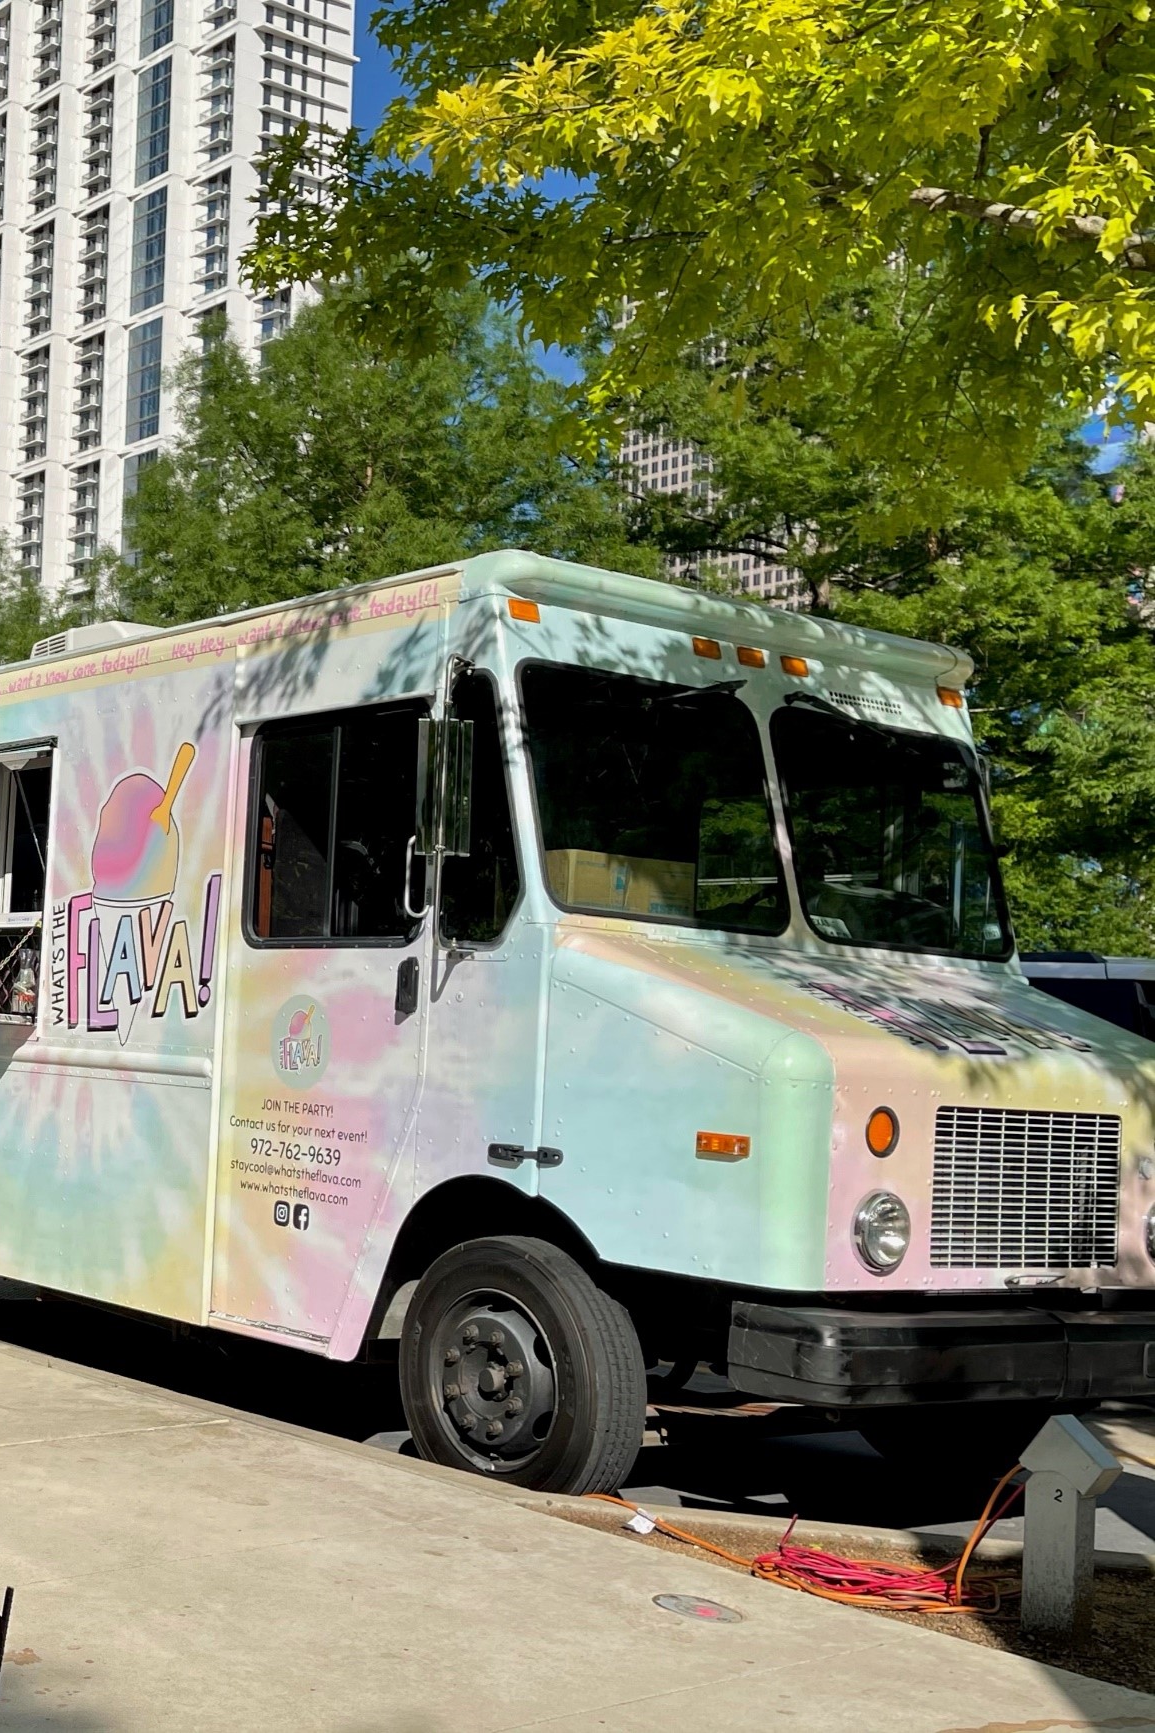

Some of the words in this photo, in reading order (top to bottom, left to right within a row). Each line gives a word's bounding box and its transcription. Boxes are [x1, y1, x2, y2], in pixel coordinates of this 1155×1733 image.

[276, 622, 283, 636] a
[370, 582, 439, 618] today!?!
[51, 902, 66, 945] THE
[67, 874, 222, 1032] FLAVA!
[51, 947, 66, 1026] WHAT'S
[261, 1099, 281, 1112] JOIN
[284, 1101, 300, 1114] THE
[302, 1103, 334, 1118] PARTY!
[230, 1115, 264, 1130] Contact
[265, 1121, 276, 1132] us
[277, 1120, 291, 1134] for
[292, 1124, 312, 1138] your
[315, 1124, 336, 1139] next
[338, 1130, 368, 1143] event!
[250, 1138, 341, 1166] 972-762-9639
[230, 1158, 362, 1188] staycool@whatstheflava.com
[240, 1179, 348, 1206] www.whatstheflava.com
[1053, 1488, 1063, 1503] 2
